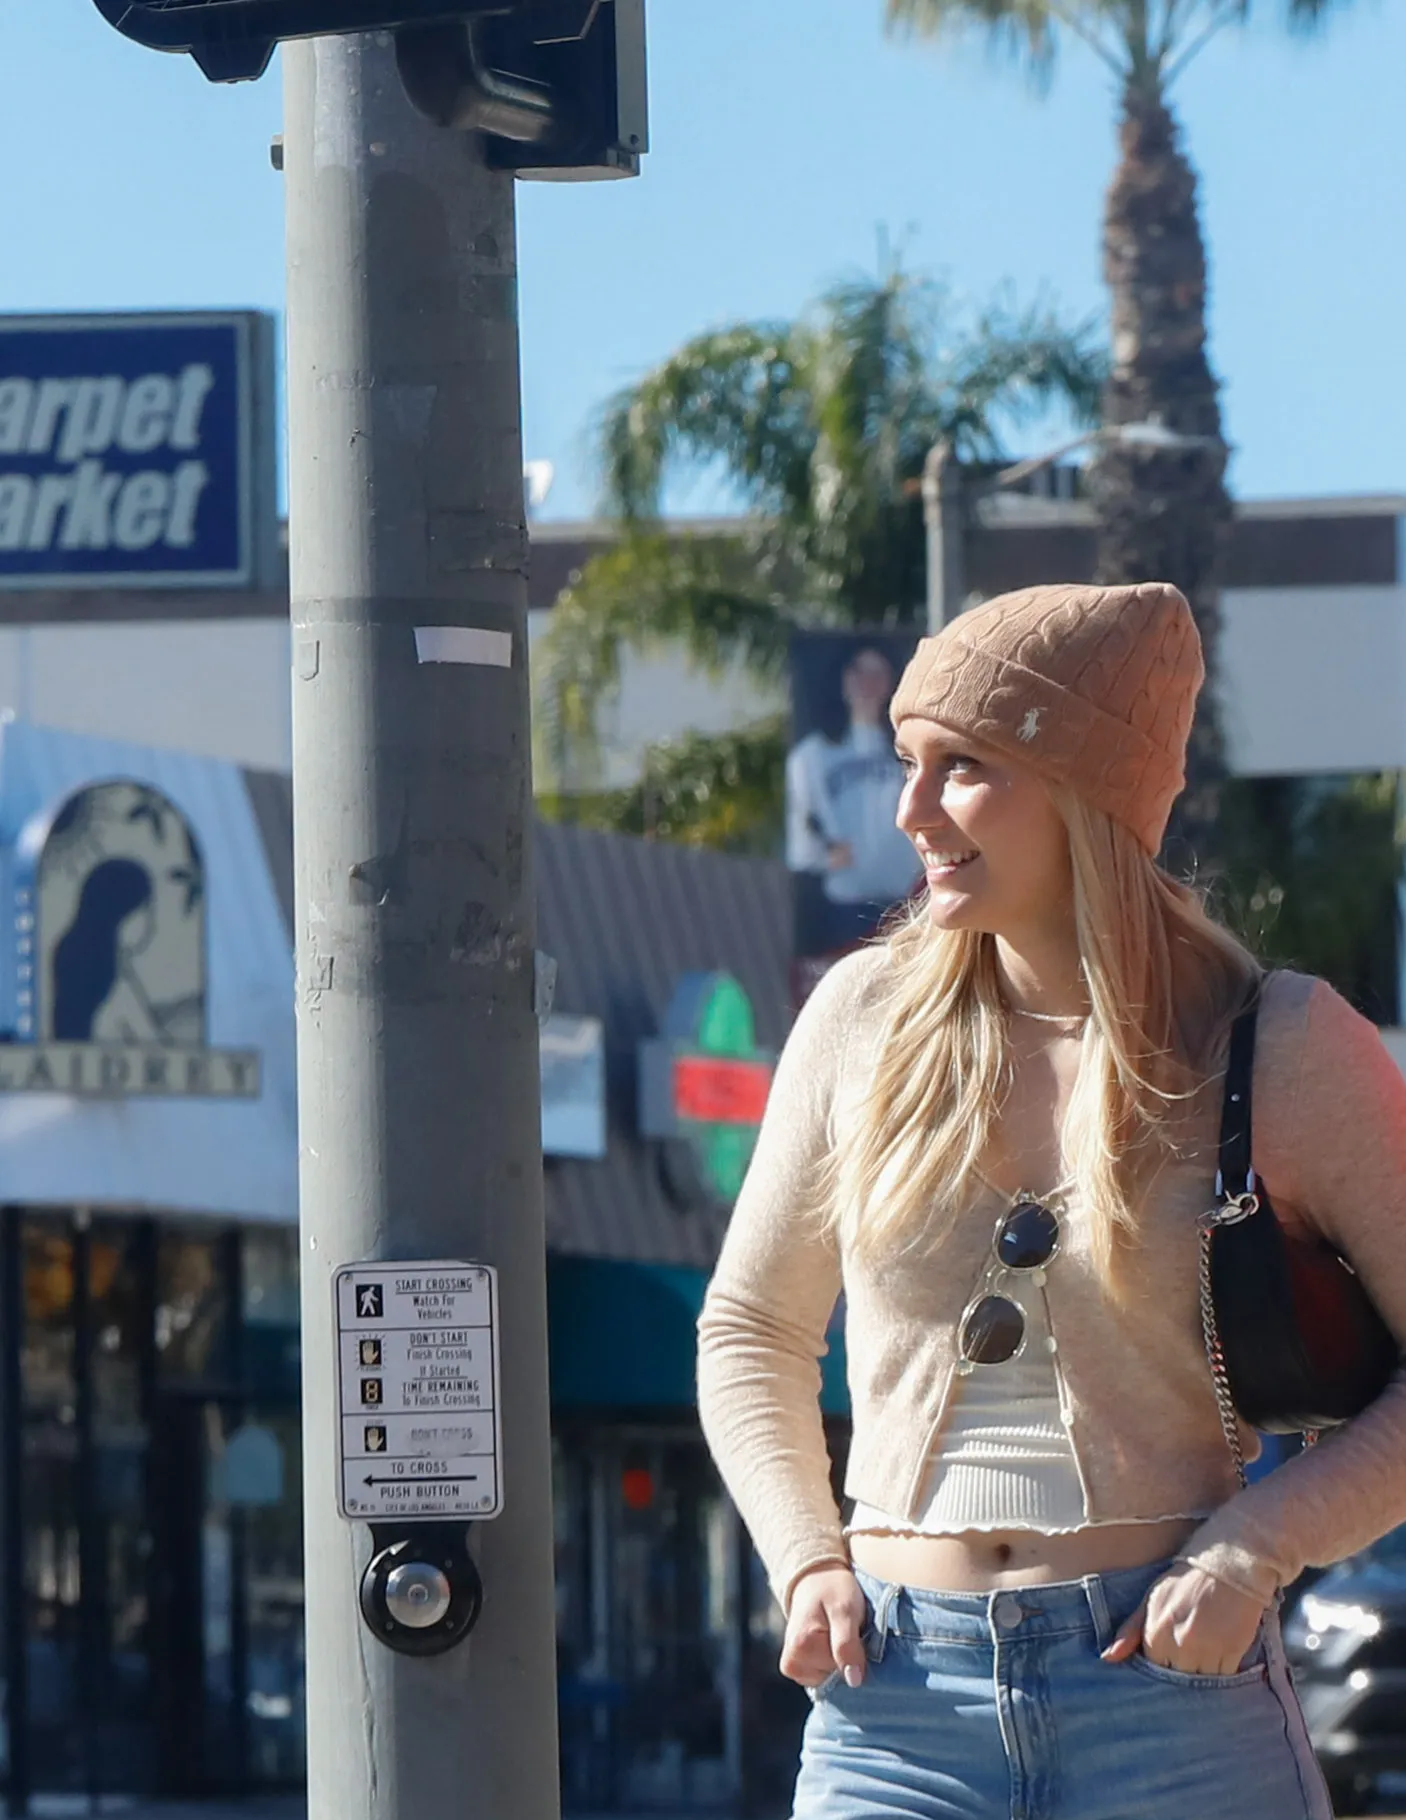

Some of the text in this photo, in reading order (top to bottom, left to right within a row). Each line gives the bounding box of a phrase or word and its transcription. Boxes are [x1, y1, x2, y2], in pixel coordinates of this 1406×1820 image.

[395, 1277, 473, 1291] START CROSSING
[413, 1293, 455, 1306] Watch For
[418, 1307, 452, 1320] Vehicles
[409, 1330, 468, 1344] DON'T START
[407, 1347, 472, 1362] Finish Crossing
[430, 1364, 460, 1377] Started
[402, 1379, 479, 1394] TIME REMAINING
[415, 1394, 440, 1407] Finish
[444, 1392, 481, 1407] Crossing
[391, 1461, 448, 1475] TO CROSS
[380, 1484, 460, 1499] PUSH BUTTON
